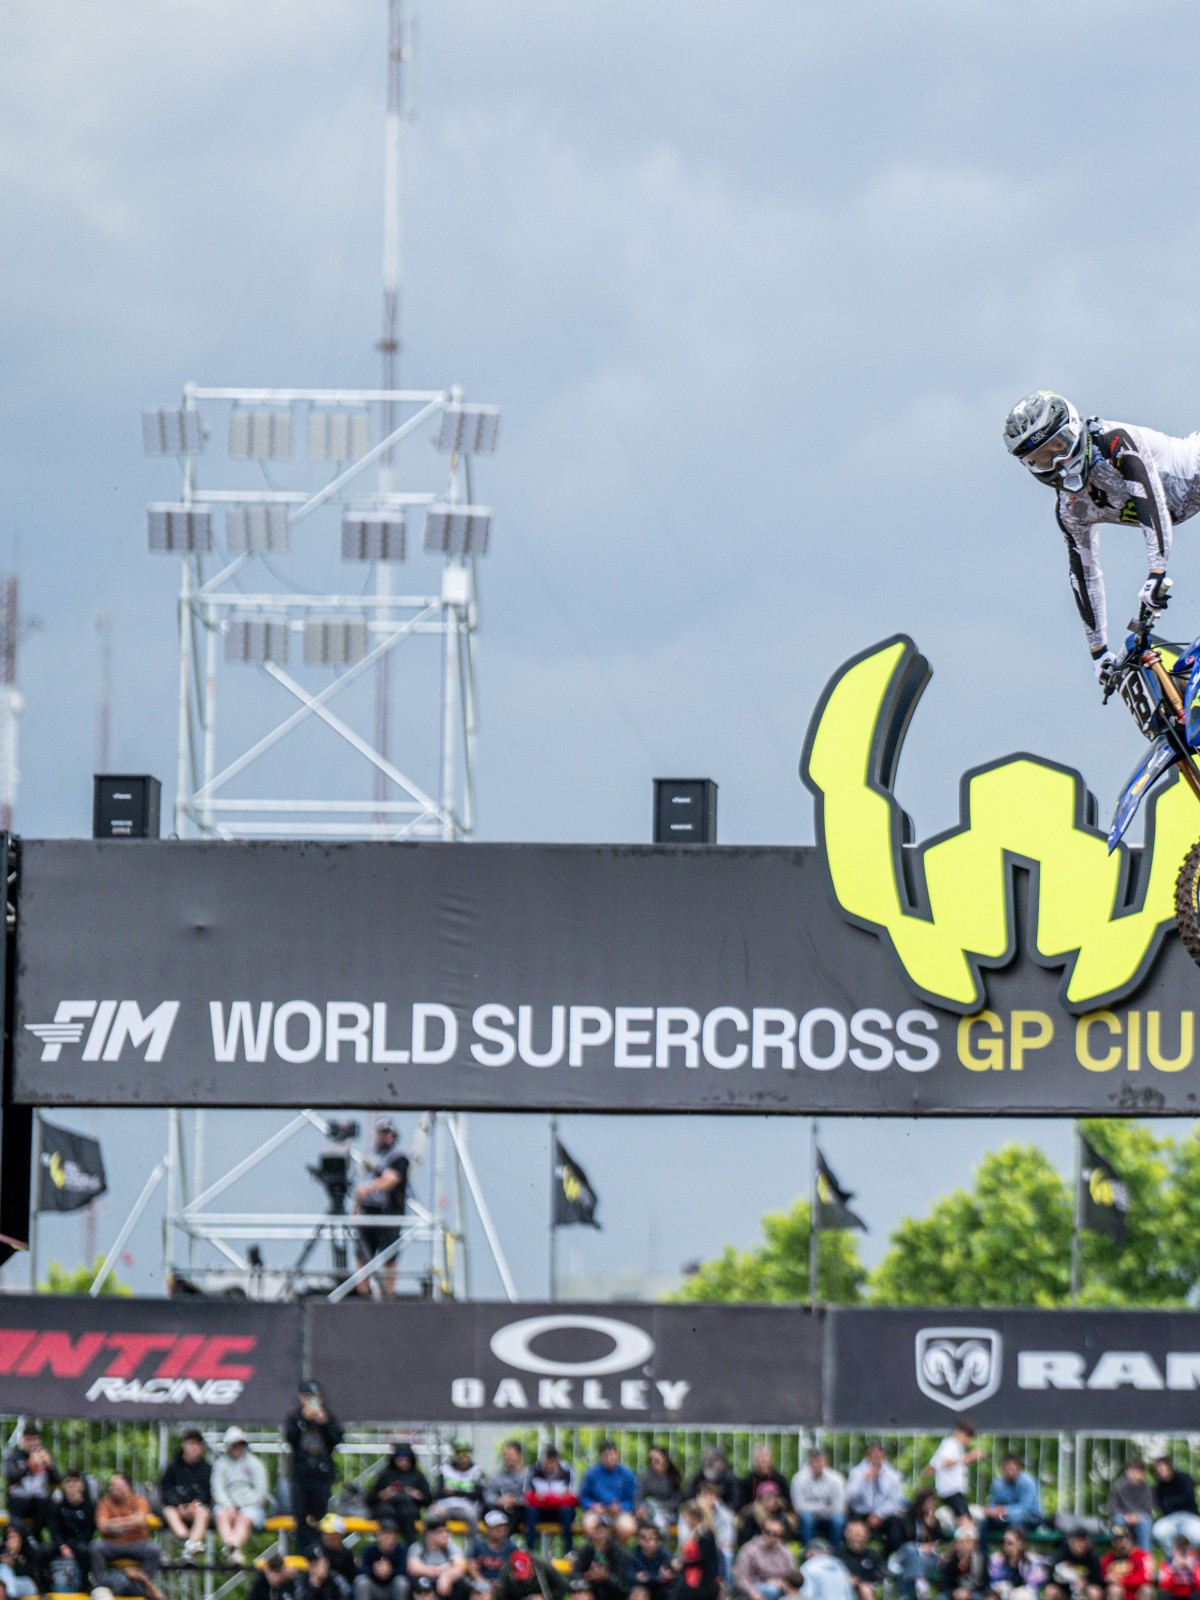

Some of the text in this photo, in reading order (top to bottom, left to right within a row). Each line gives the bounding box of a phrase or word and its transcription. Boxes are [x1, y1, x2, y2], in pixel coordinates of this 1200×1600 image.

[24, 1000, 180, 1063] FIM
[209, 1000, 458, 1064] WORLD
[470, 1003, 941, 1072] SUPERCROSS
[956, 1009, 1054, 1072] GP
[85, 1377, 244, 1405] RACING
[451, 1377, 690, 1410] OAKLEY
